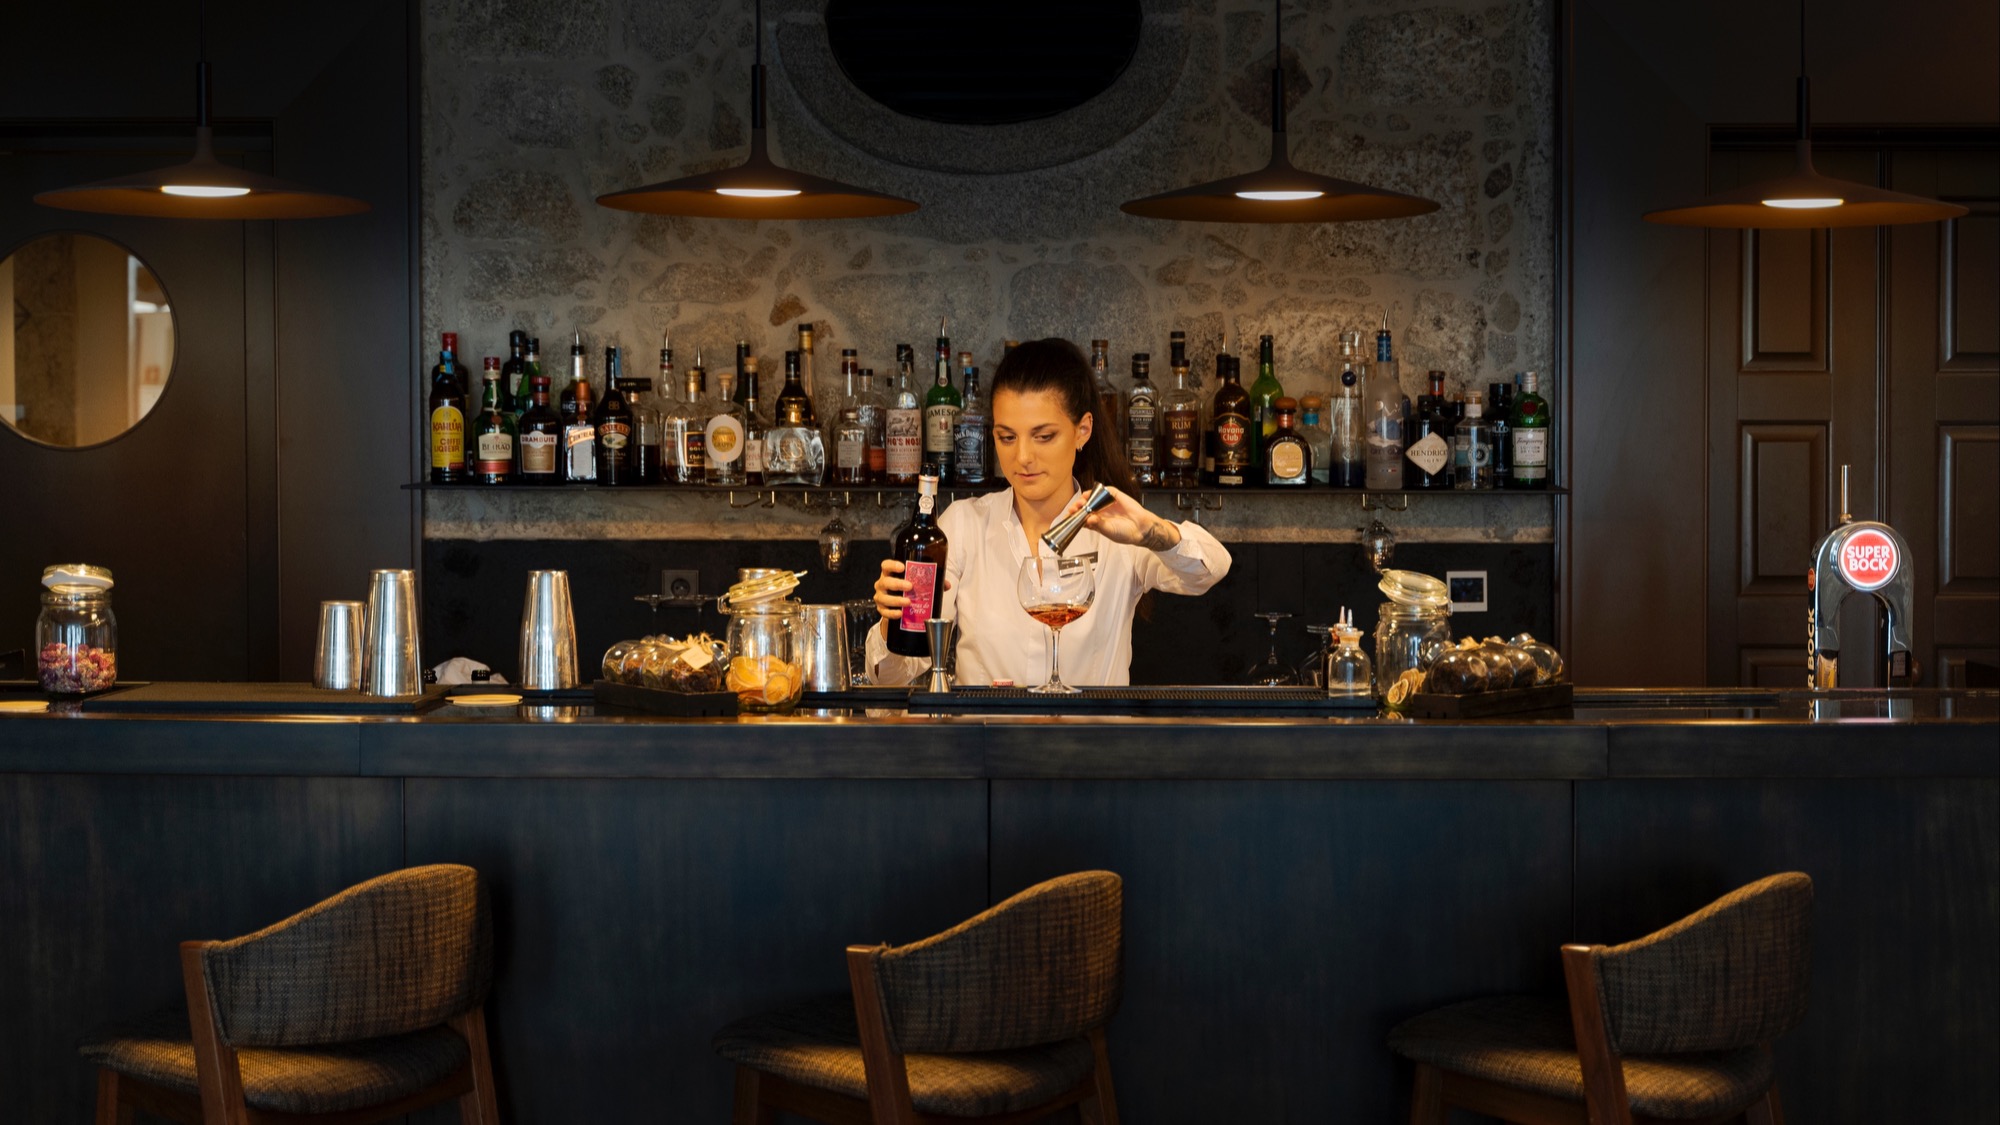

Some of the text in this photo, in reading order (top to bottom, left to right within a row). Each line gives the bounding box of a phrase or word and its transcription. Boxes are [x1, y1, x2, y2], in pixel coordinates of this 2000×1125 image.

[926, 409, 961, 419] JAMESO
[1171, 421, 1191, 430] RUM
[1218, 425, 1244, 434] Havana
[1222, 434, 1239, 442] Club
[1227, 451, 1235, 460] 7
[1846, 545, 1890, 559] SUPER
[1849, 558, 1889, 572] BOCK
[1807, 607, 1815, 671] BOCK
